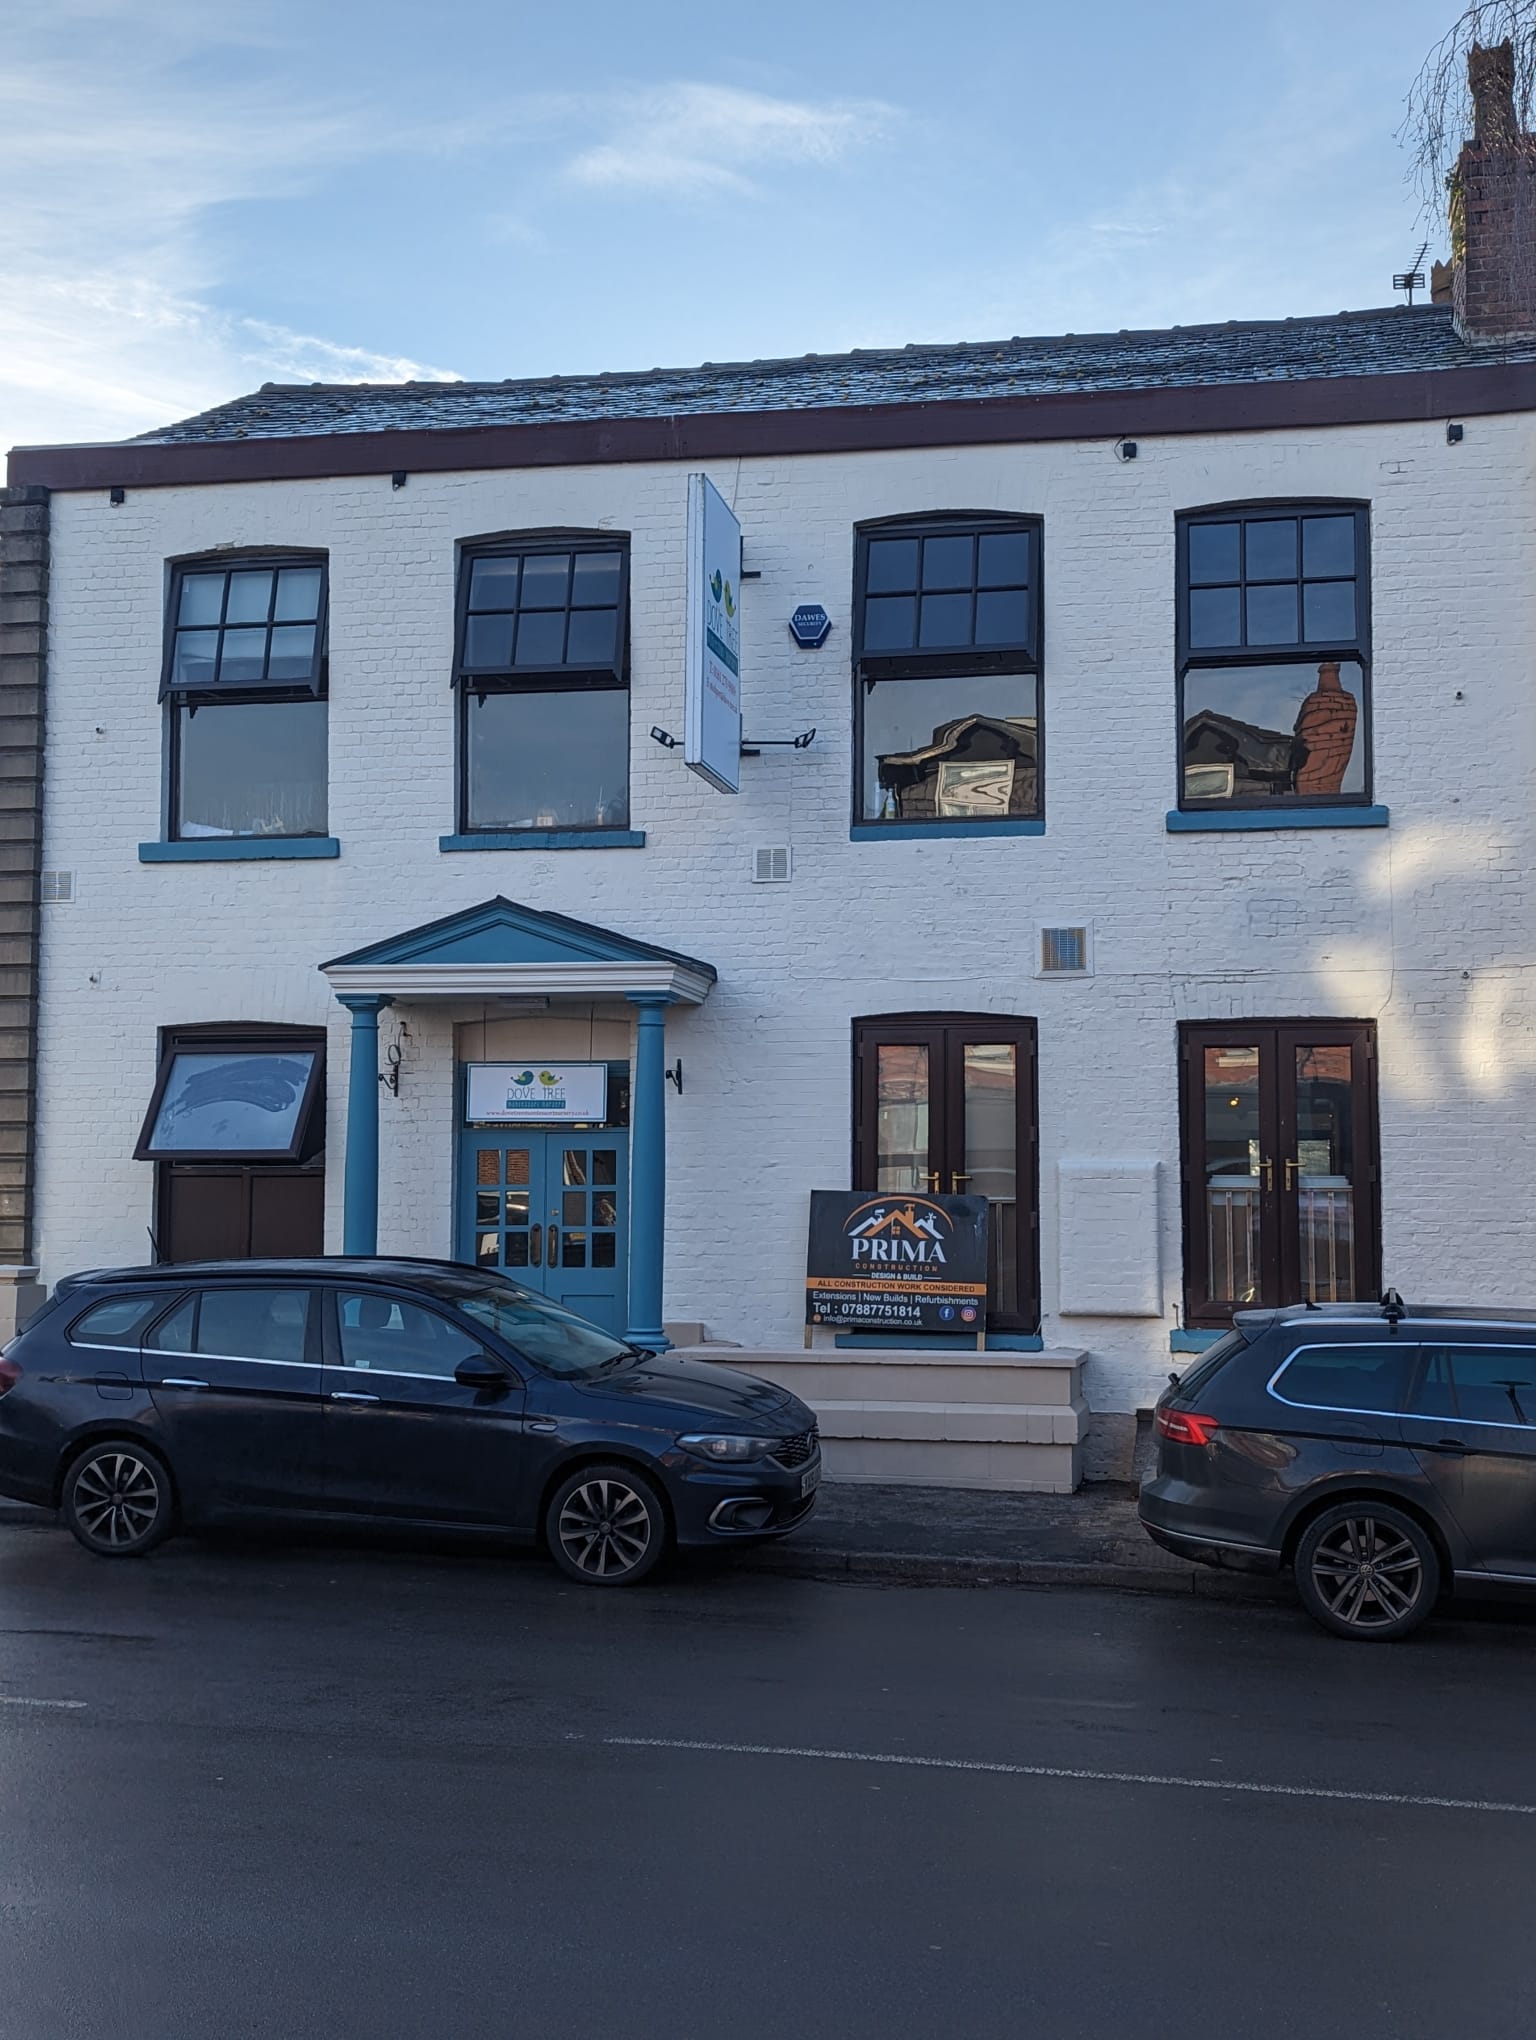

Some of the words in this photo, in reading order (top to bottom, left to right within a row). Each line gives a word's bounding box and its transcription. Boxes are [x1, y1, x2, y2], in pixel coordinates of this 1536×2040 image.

[707, 599, 723, 640] DOVE
[794, 613, 826, 622] DAWES
[507, 1087, 536, 1100] DOVE
[542, 1087, 566, 1100] TREE
[852, 1238, 948, 1263] PRIMA
[855, 1263, 938, 1272] CONSTRUCTION
[871, 1272, 896, 1280] DESIGN
[903, 1273, 923, 1281] BUILD
[817, 1280, 832, 1288] ALL
[834, 1281, 896, 1290] CONSTRUCTION
[897, 1283, 922, 1291] WORK
[923, 1284, 975, 1293] CONSIDERED
[812, 1291, 857, 1300] Extensions
[863, 1293, 882, 1301] New
[883, 1293, 909, 1303] Builds
[915, 1295, 979, 1306] Refurbishments
[813, 1303, 831, 1314] Tel
[841, 1304, 921, 1317] 07887751814
[823, 1315, 923, 1326] info@primaconstruction.co.uk
